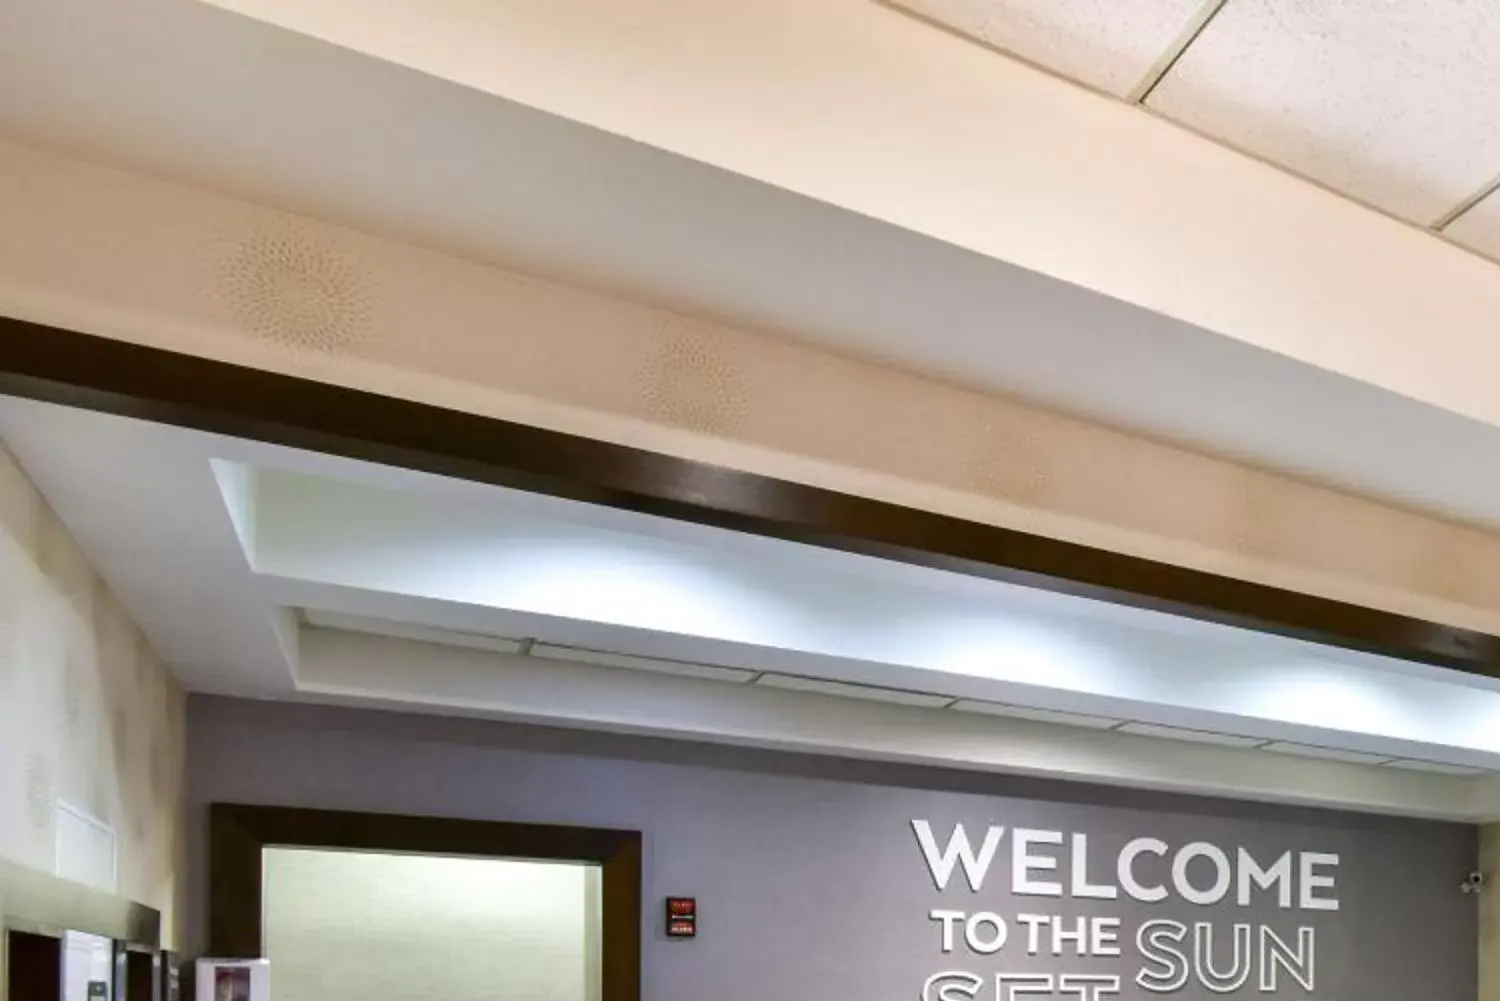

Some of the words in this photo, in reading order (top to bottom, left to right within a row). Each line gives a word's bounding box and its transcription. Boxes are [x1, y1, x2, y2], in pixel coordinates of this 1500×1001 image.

[910, 819, 1339, 910] WELCOME
[929, 910, 1008, 954] TO
[1016, 913, 1121, 956] THE
[1136, 919, 1316, 993] SUN
